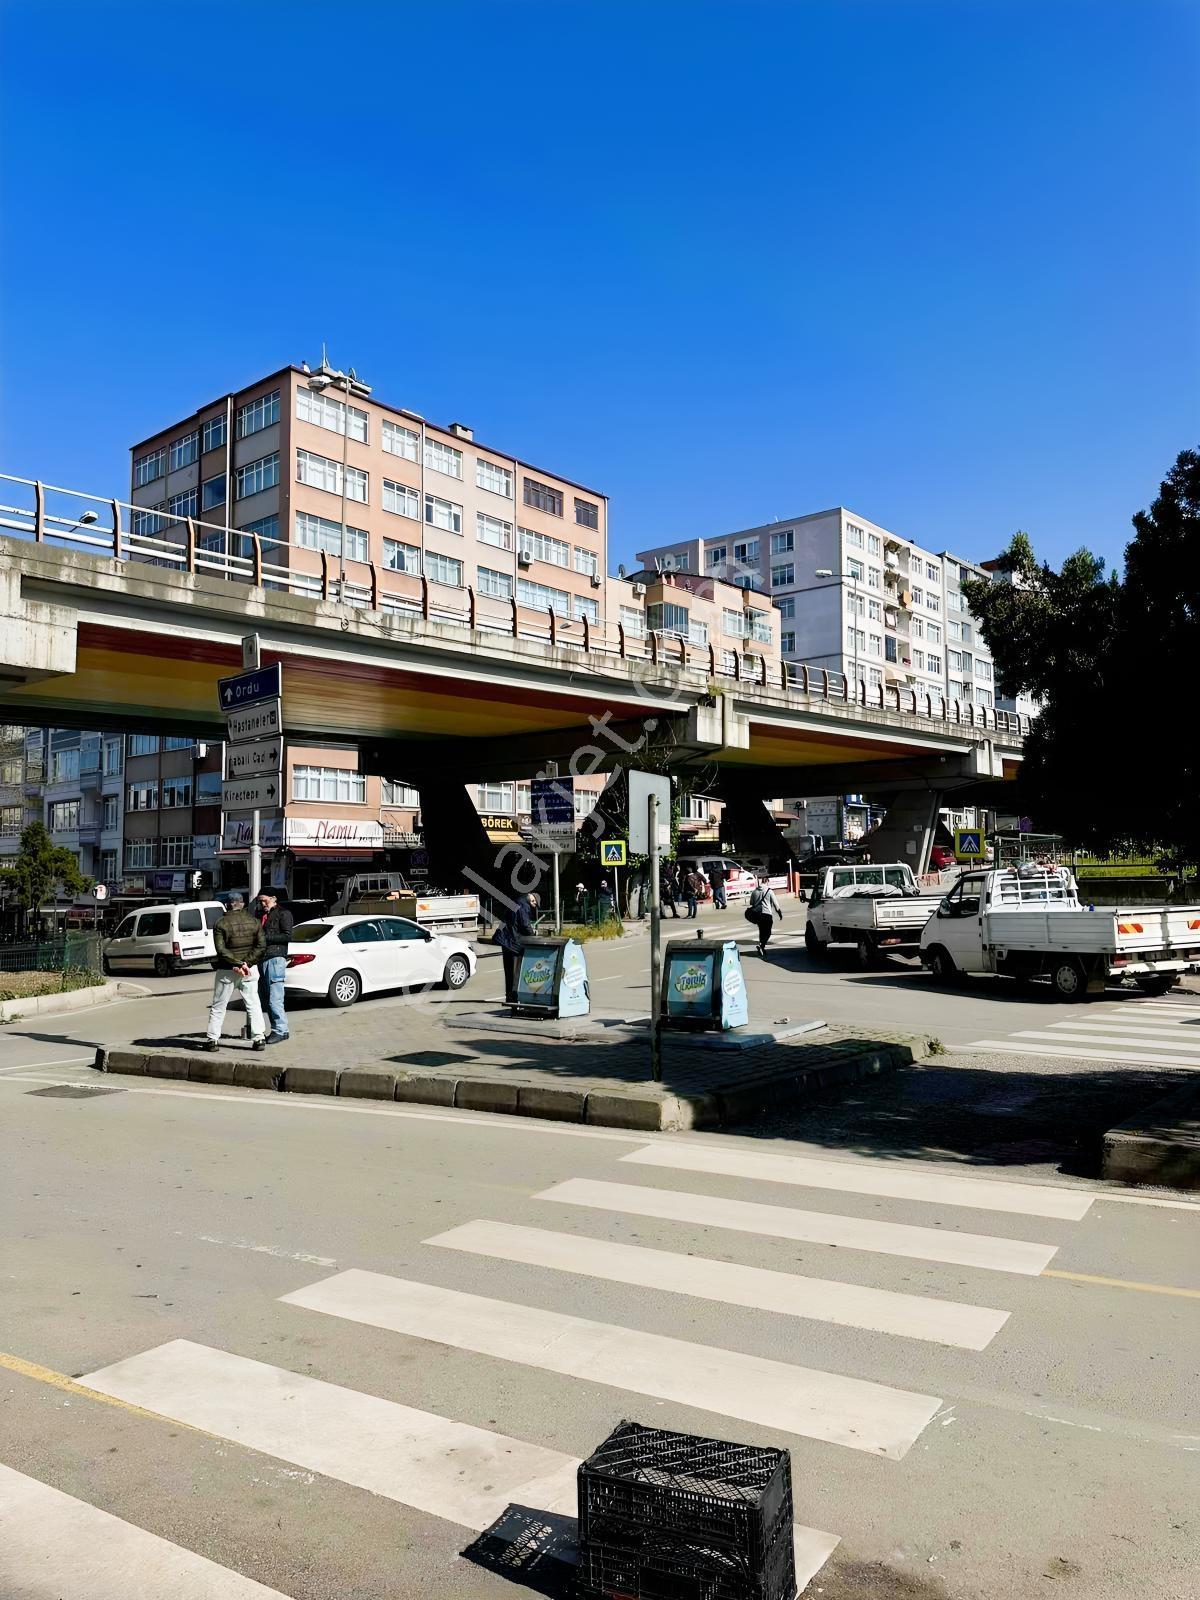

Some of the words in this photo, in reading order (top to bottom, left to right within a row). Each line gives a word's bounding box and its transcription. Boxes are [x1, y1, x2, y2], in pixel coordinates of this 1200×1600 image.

[235, 682, 259, 698] Ordu
[233, 714, 269, 733] Hastaneler
[481, 816, 513, 829] BÖREK
